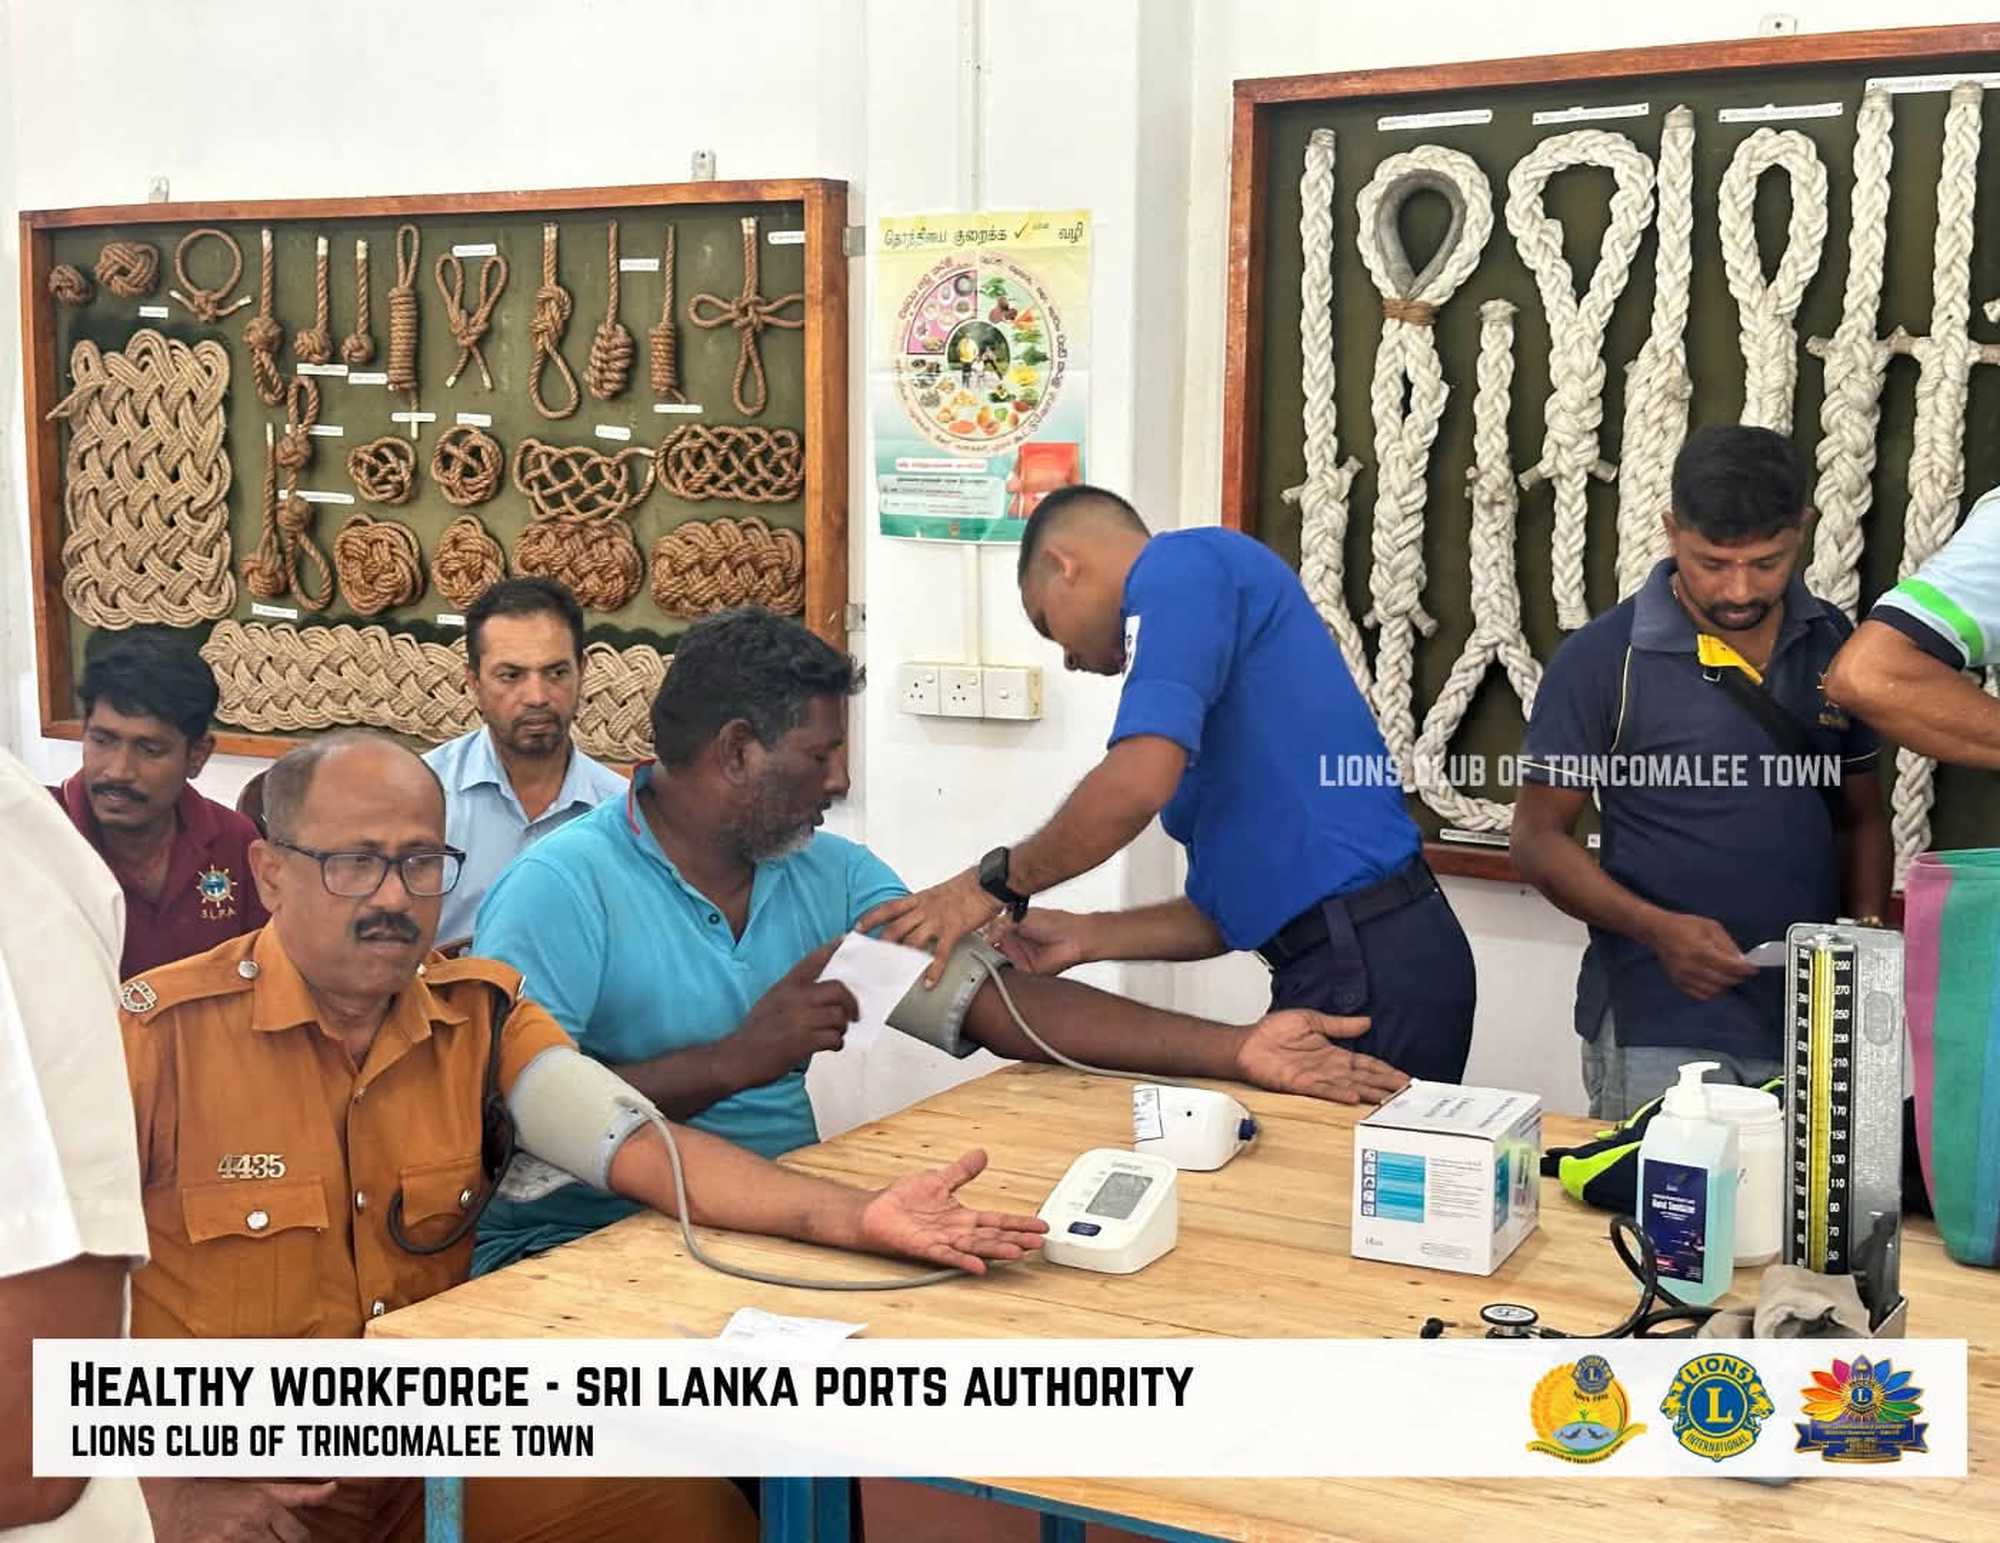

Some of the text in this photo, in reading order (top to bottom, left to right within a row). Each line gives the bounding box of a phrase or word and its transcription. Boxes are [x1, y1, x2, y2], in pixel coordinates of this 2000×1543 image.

[1058, 221, 1084, 244] வழி
[1831, 1106, 1847, 1116] 170
[1831, 1154, 1846, 1164] 130
[217, 1153, 287, 1180] 4435
[1830, 1178, 1845, 1189] 110
[1829, 1226, 1840, 1237] 70
